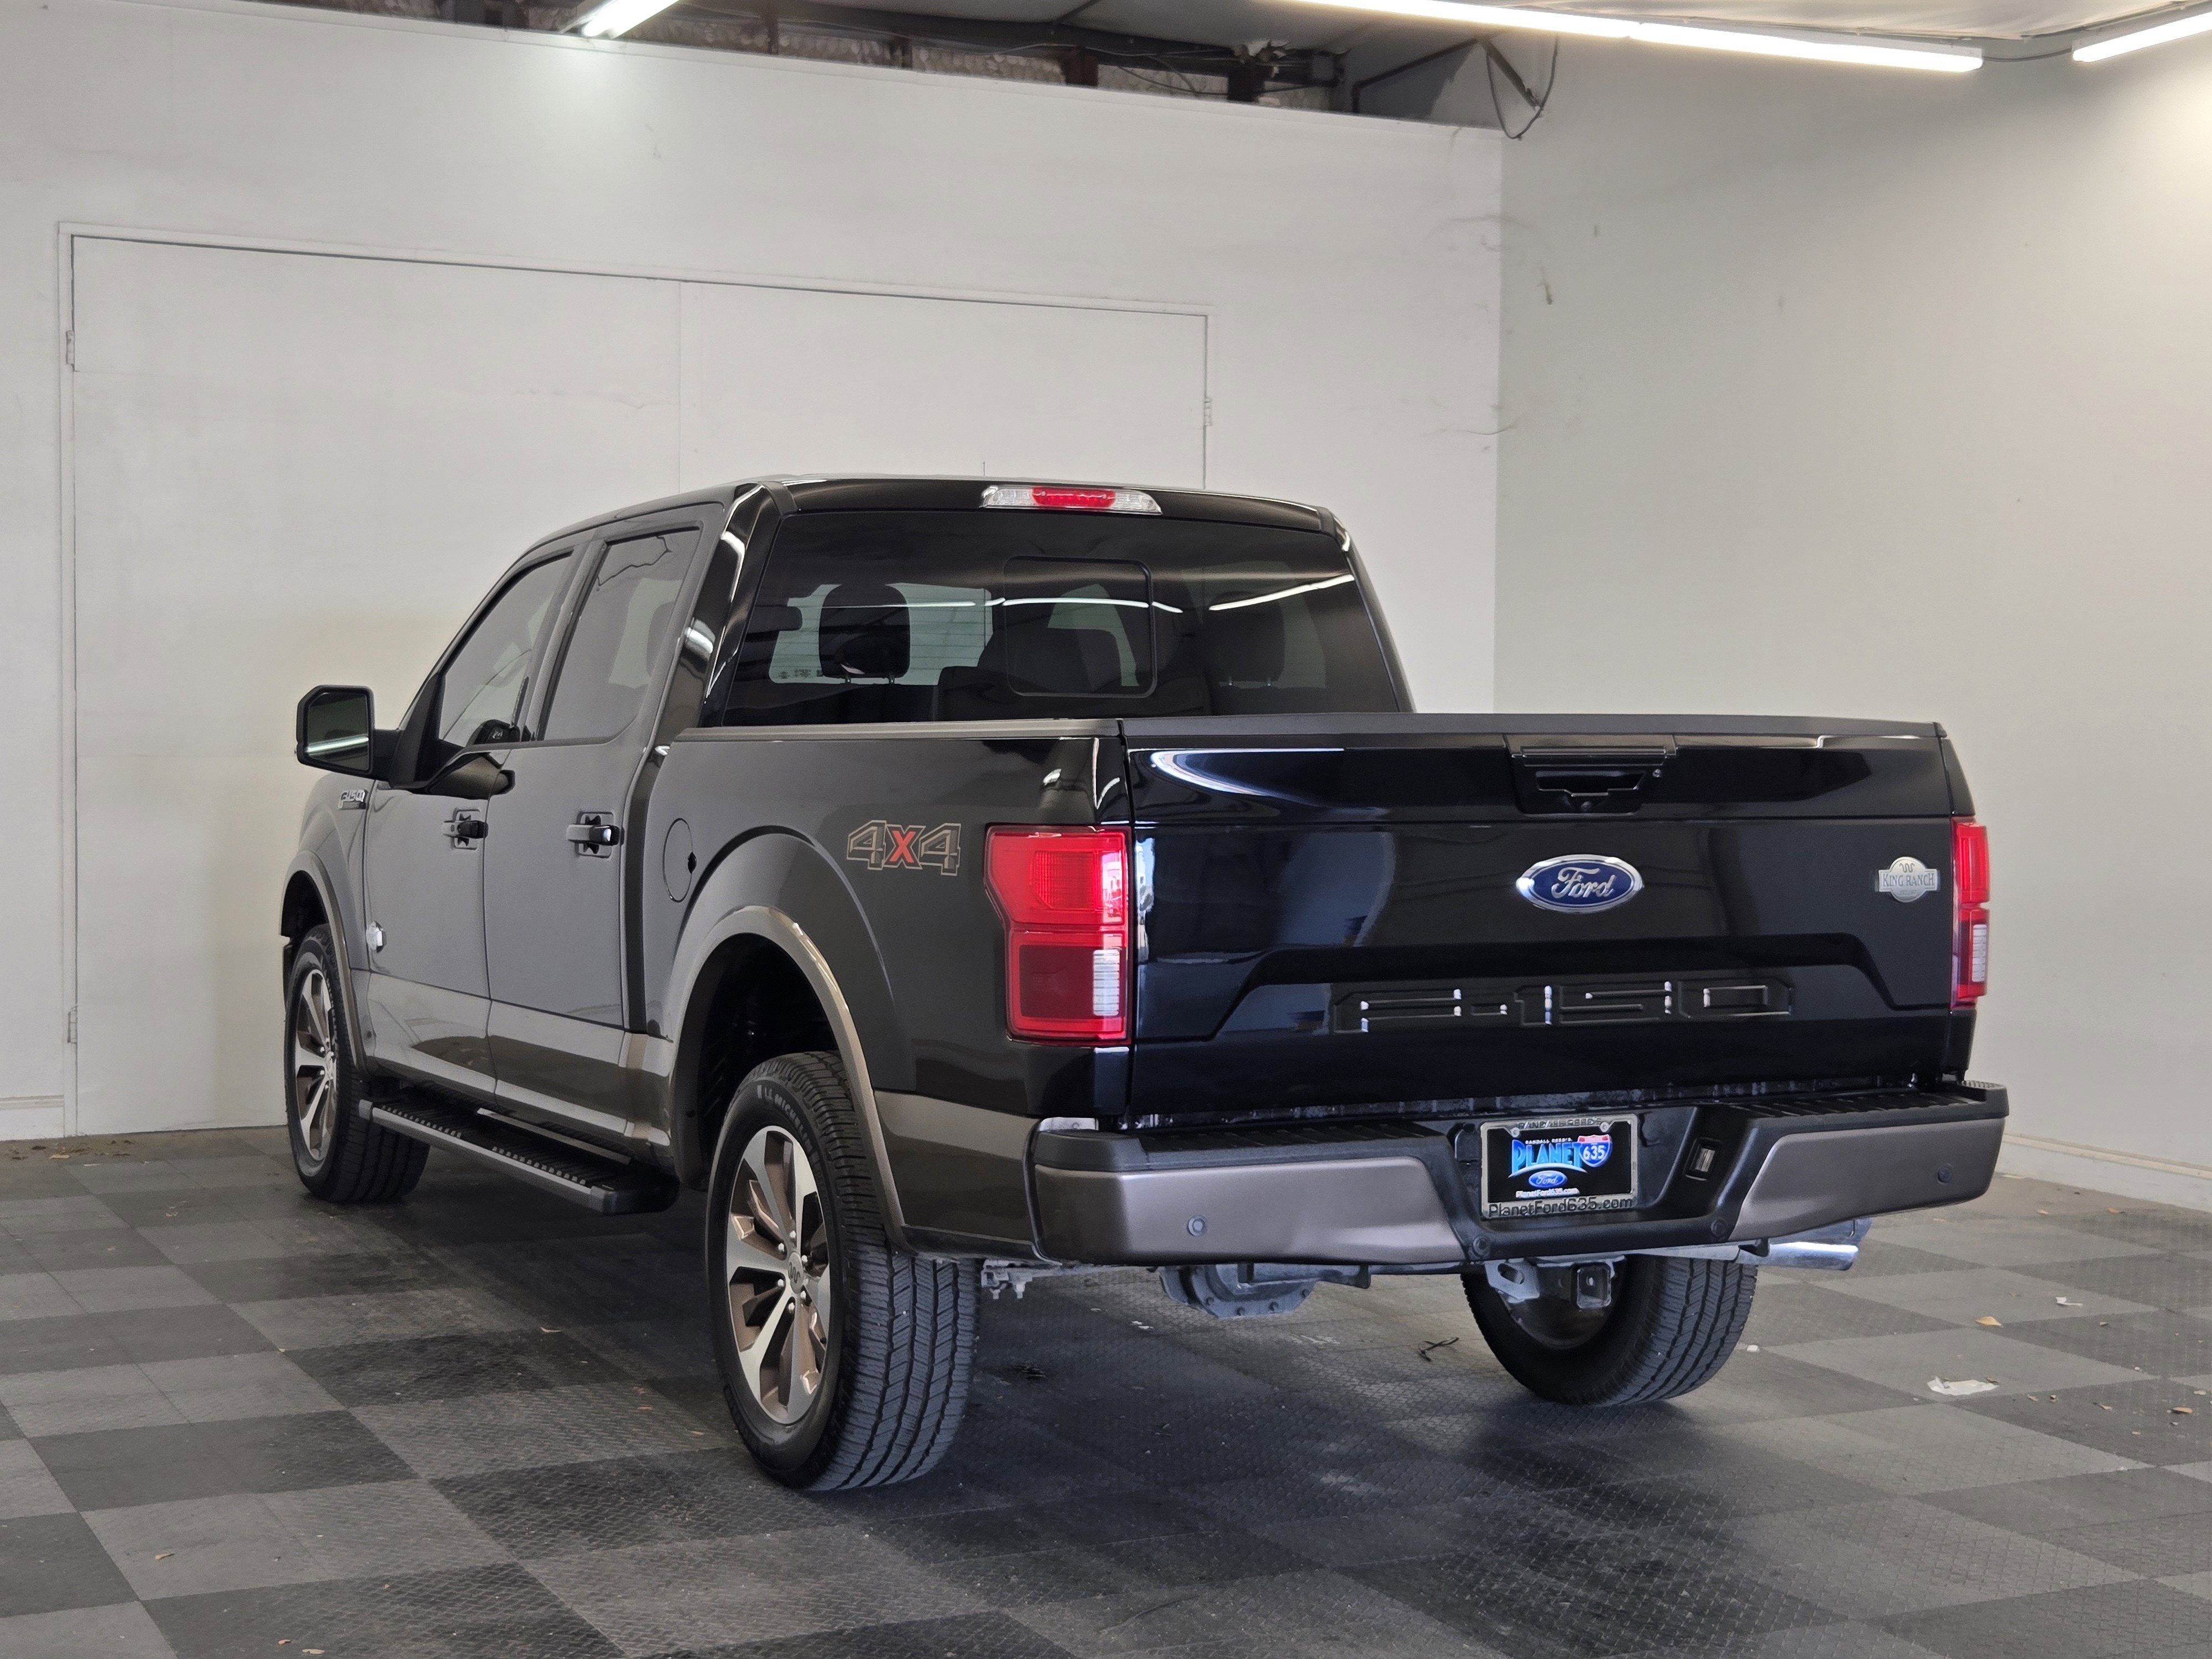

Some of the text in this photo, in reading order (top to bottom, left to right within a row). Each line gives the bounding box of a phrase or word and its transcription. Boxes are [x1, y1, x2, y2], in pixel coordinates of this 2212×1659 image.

[1551, 867, 1615, 898] Ford
[1882, 873, 1935, 886] KING RANCH
[774, 1093, 813, 1154] MICHELIN
[1511, 1139, 1583, 1173] PLANET
[1583, 1145, 1605, 1160] 635
[1535, 1172, 1558, 1185] Ford
[1488, 1196, 1634, 1217] PlanetFord635.com
